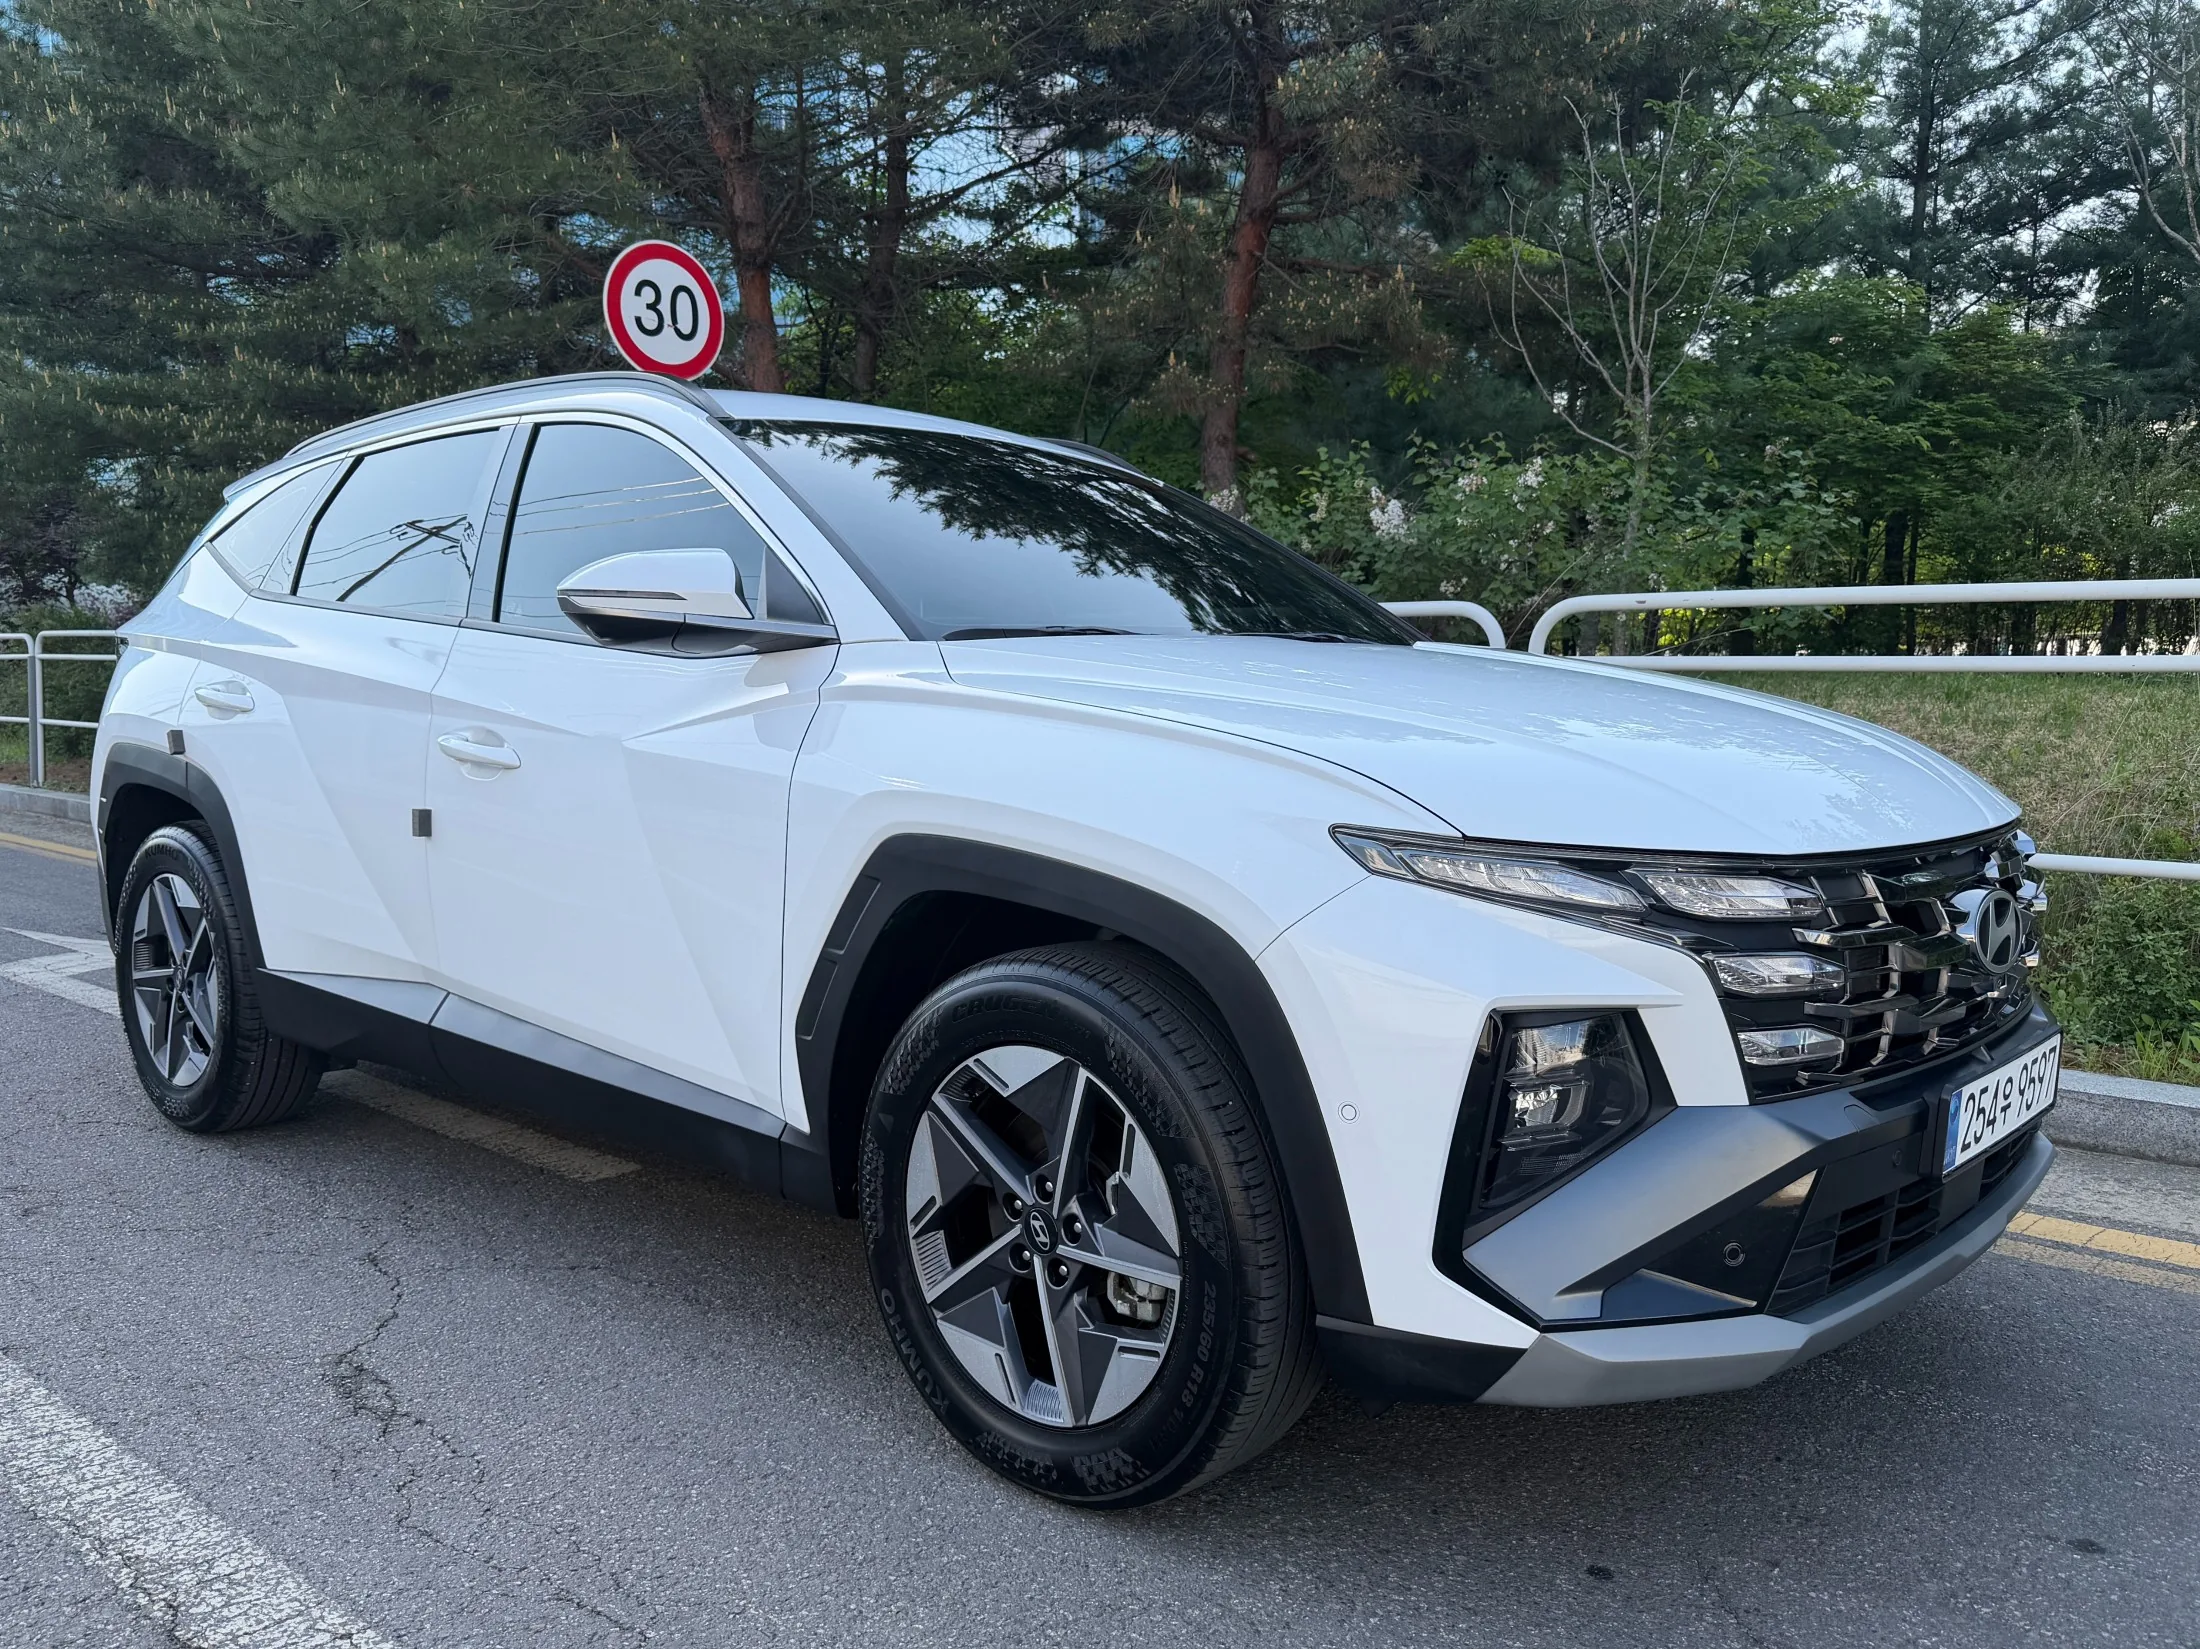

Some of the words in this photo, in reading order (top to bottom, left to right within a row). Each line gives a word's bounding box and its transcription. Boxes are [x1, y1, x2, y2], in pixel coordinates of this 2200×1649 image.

[634, 279, 699, 342] 30
[144, 843, 178, 861] KUMHO
[951, 993, 1061, 1022] CRUGEN
[1960, 1075, 2014, 1155] 254우
[2016, 1044, 2058, 1119] 9597
[881, 1287, 950, 1416] KUMHO
[1196, 1280, 1217, 1363] 235/60
[1180, 1362, 1205, 1409] R18
